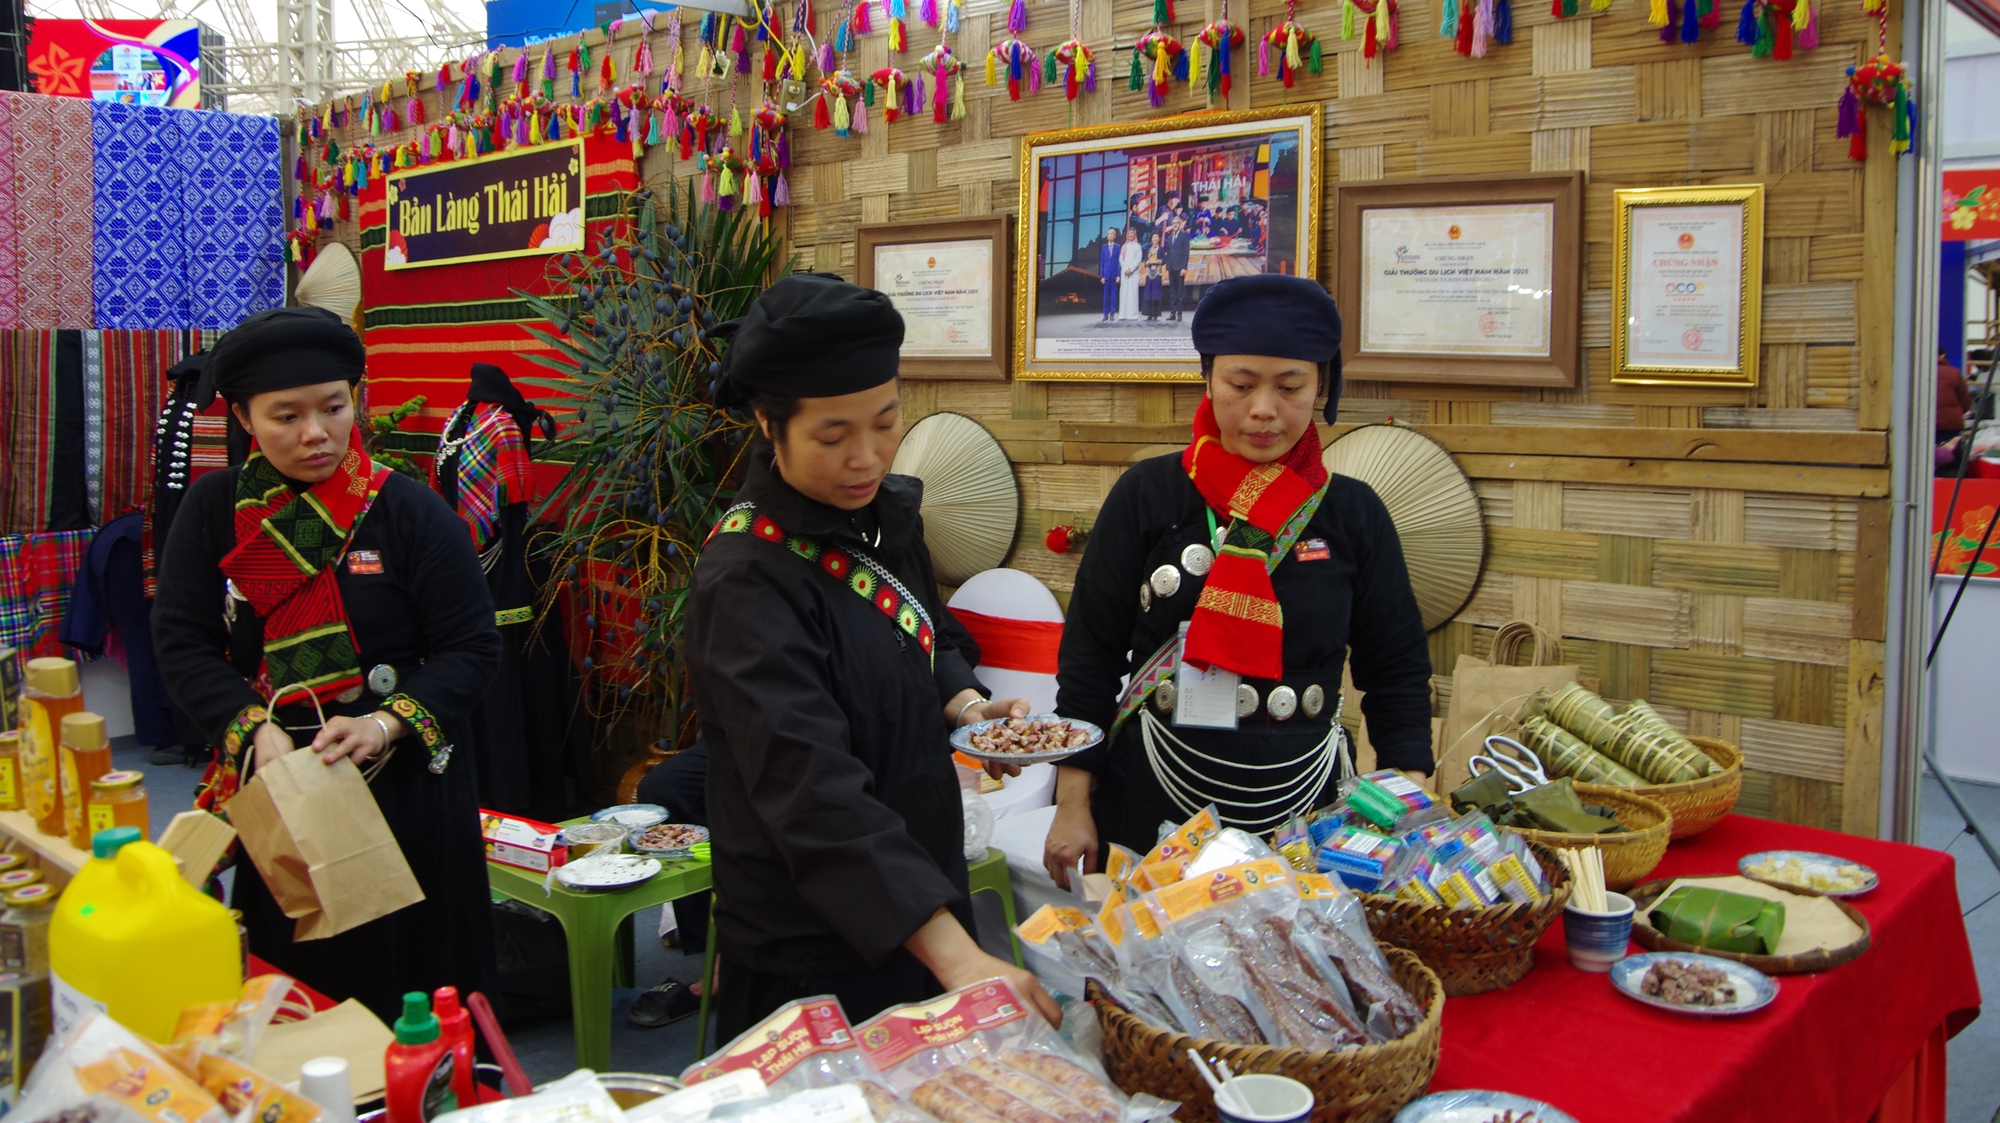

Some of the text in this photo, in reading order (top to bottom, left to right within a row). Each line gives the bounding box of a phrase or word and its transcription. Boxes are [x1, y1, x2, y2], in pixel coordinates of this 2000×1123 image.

[1191, 174, 1247, 193] THÁI HẢI
[399, 172, 568, 237] Bản Làng Thái Hải
[1652, 256, 1719, 268] CHỨNG NHẬN
[1399, 268, 1428, 276] THƯỞNG
[1457, 268, 1474, 276] VIỆT
[1493, 267, 1511, 275] NĂM
[1665, 282, 1706, 294] OCOP
[923, 1032, 946, 1044] THÁI
[751, 1046, 778, 1069] LẠP
[764, 1051, 794, 1075] THÁI
